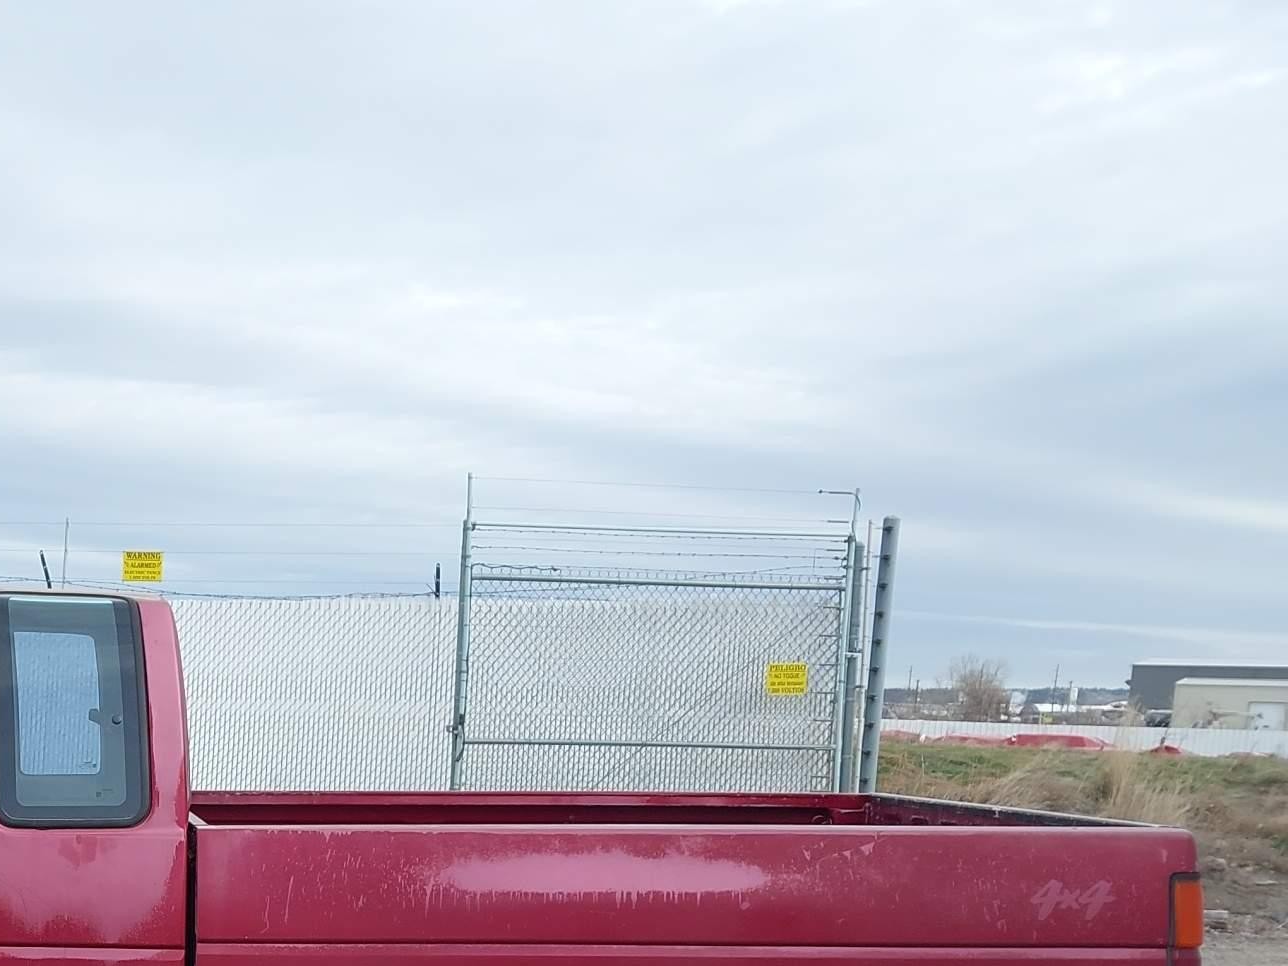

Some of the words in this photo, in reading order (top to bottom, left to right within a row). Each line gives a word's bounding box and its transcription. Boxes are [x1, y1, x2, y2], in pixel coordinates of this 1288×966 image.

[125, 551, 161, 560] WARNING
[769, 664, 807, 672] PELIGRO
[1030, 879, 1117, 920] 4x4
